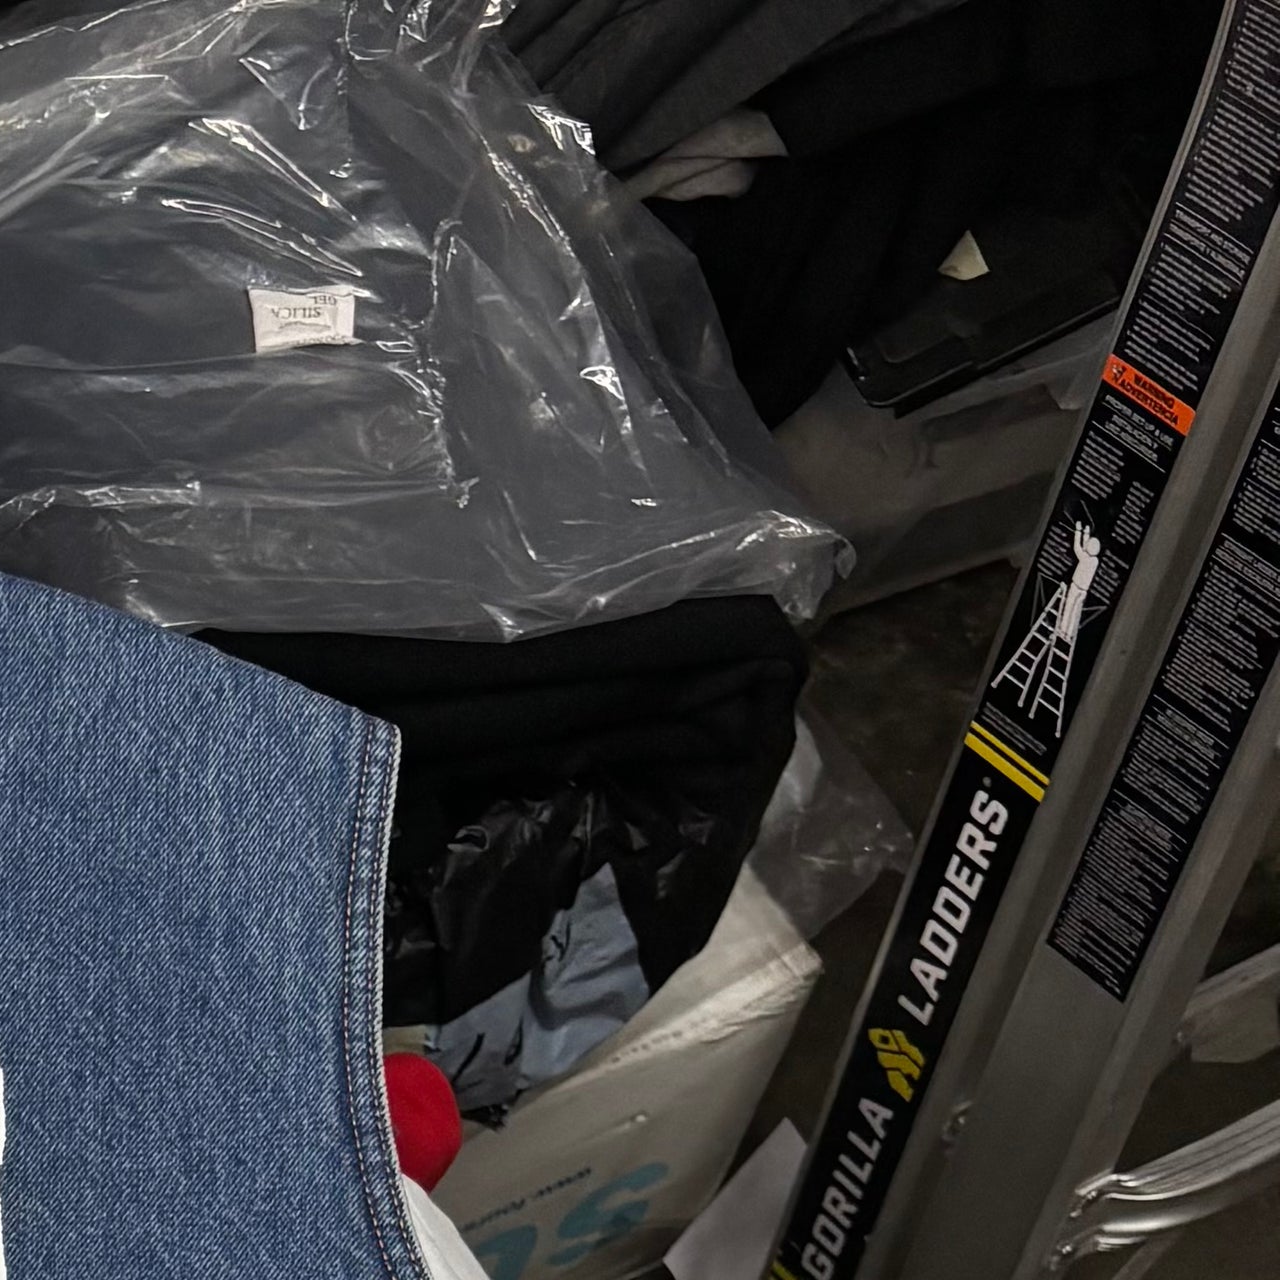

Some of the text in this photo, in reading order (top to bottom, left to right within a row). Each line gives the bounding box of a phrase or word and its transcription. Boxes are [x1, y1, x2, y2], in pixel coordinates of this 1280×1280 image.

[313, 295, 337, 306] GEL
[271, 306, 322, 319] SILICA
[898, 790, 1009, 1026] LADDERS
